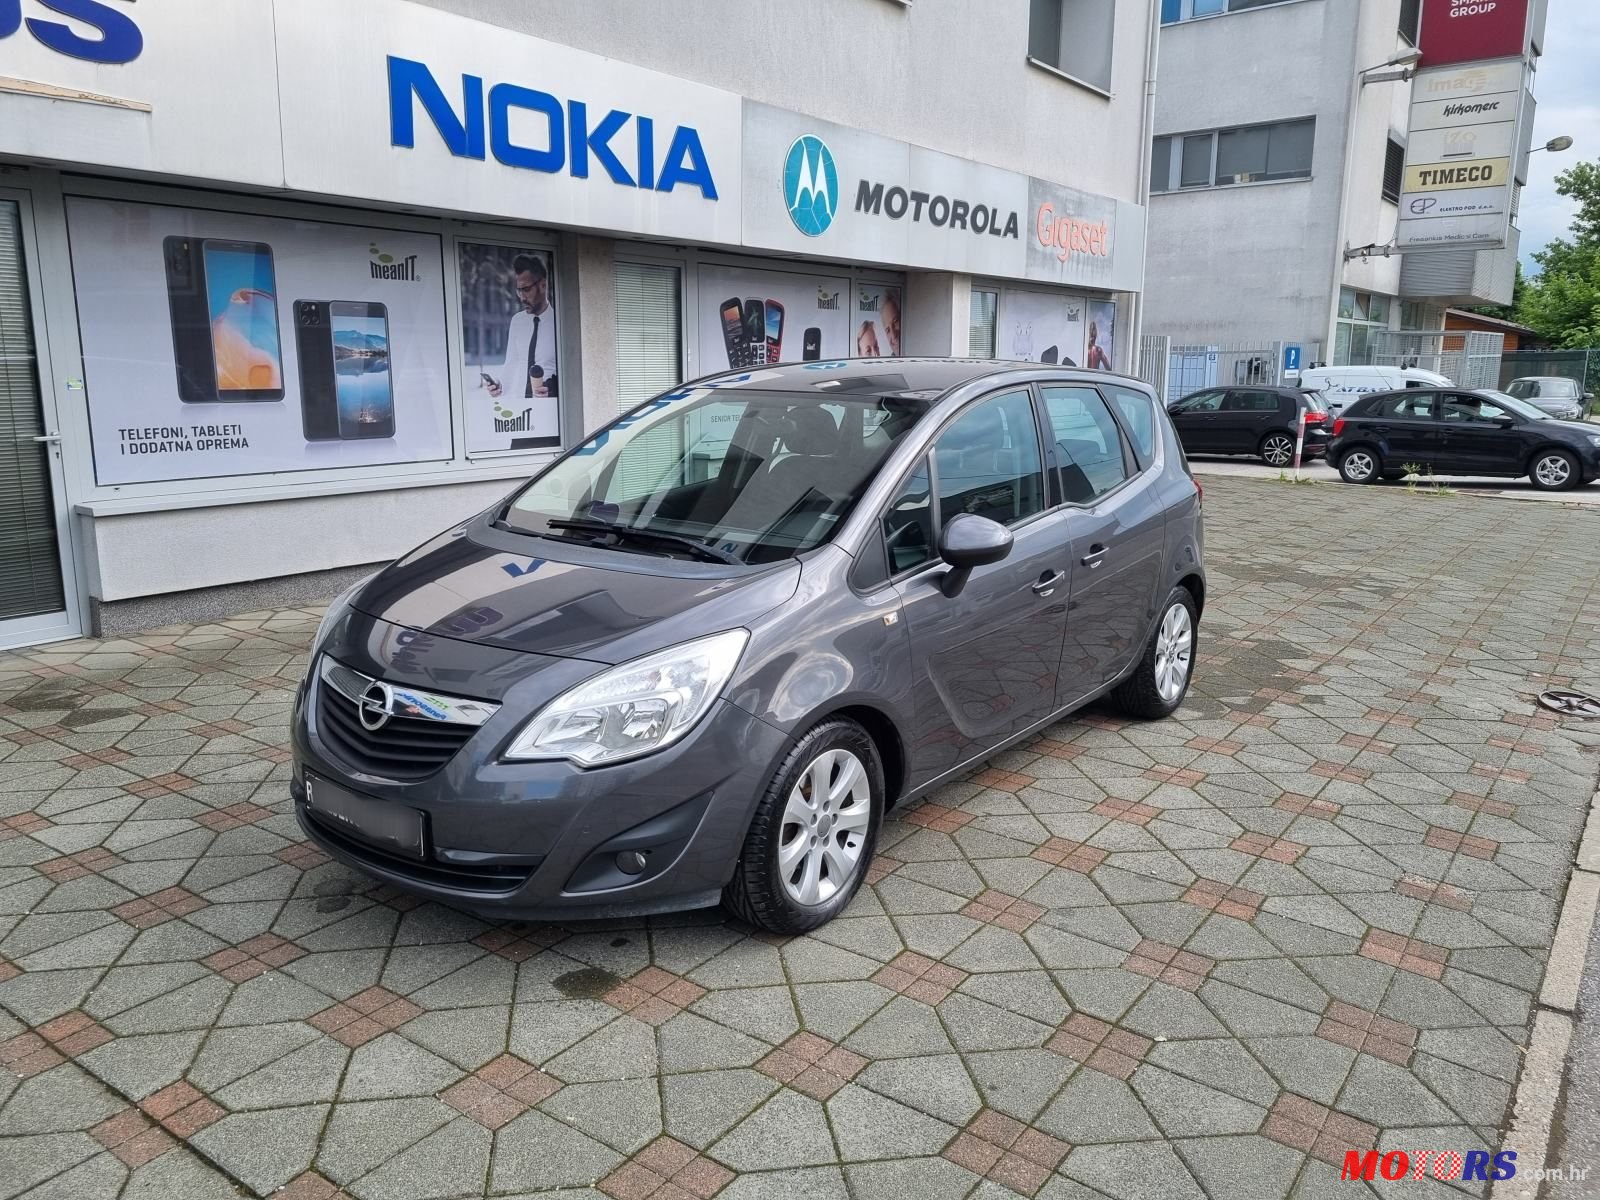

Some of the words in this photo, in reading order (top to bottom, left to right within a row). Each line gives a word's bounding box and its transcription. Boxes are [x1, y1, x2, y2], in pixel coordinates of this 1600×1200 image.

[1450, 3, 1496, 17] GROUP
[1443, 102, 1499, 117] kirkomerc
[387, 54, 718, 201] NOKIA
[1419, 165, 1492, 186] TIMECO
[854, 179, 1019, 239] MOTOROLA
[1036, 202, 1109, 263] Gigaset
[370, 255, 417, 281] meanIT
[494, 408, 532, 432] meanIT
[118, 427, 188, 440] TELEFONI,
[191, 424, 242, 437] TABLETI
[120, 443, 125, 455] I
[129, 441, 193, 454] DODATNA
[197, 438, 249, 450] OPREMA
